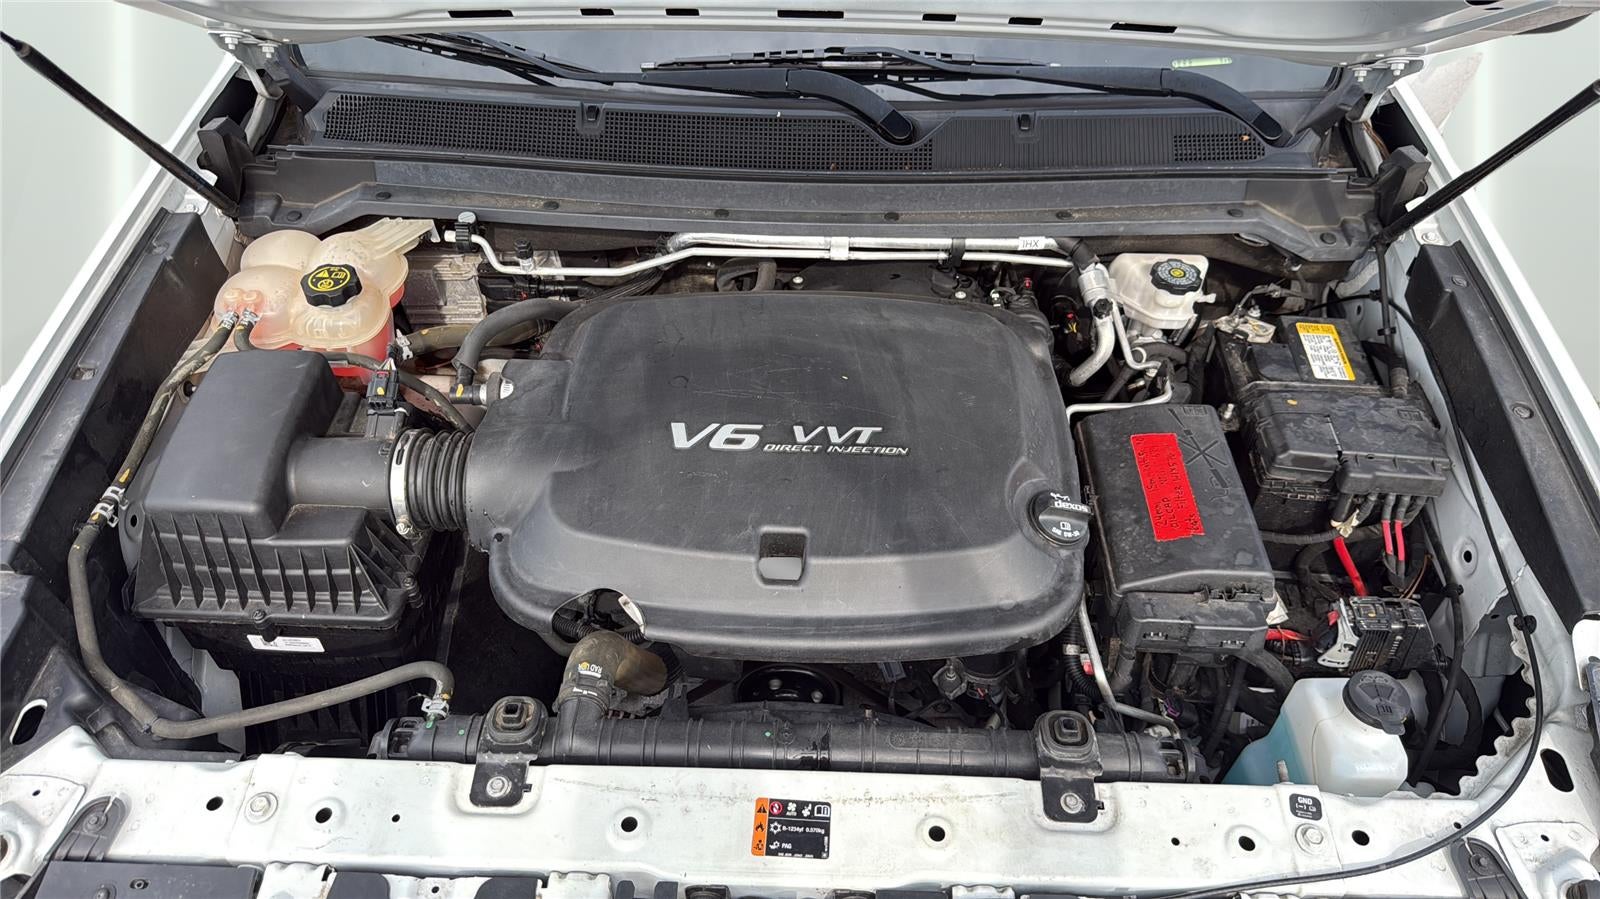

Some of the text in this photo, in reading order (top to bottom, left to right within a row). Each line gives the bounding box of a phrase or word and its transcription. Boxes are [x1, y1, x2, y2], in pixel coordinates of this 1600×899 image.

[1022, 239, 1040, 248] IHX
[670, 422, 883, 450] V6 VVT
[763, 443, 909, 456] DIRECT INJECTION
[1055, 500, 1088, 512] dexos
[590, 664, 603, 674] RAD
[1297, 796, 1313, 805] GND
